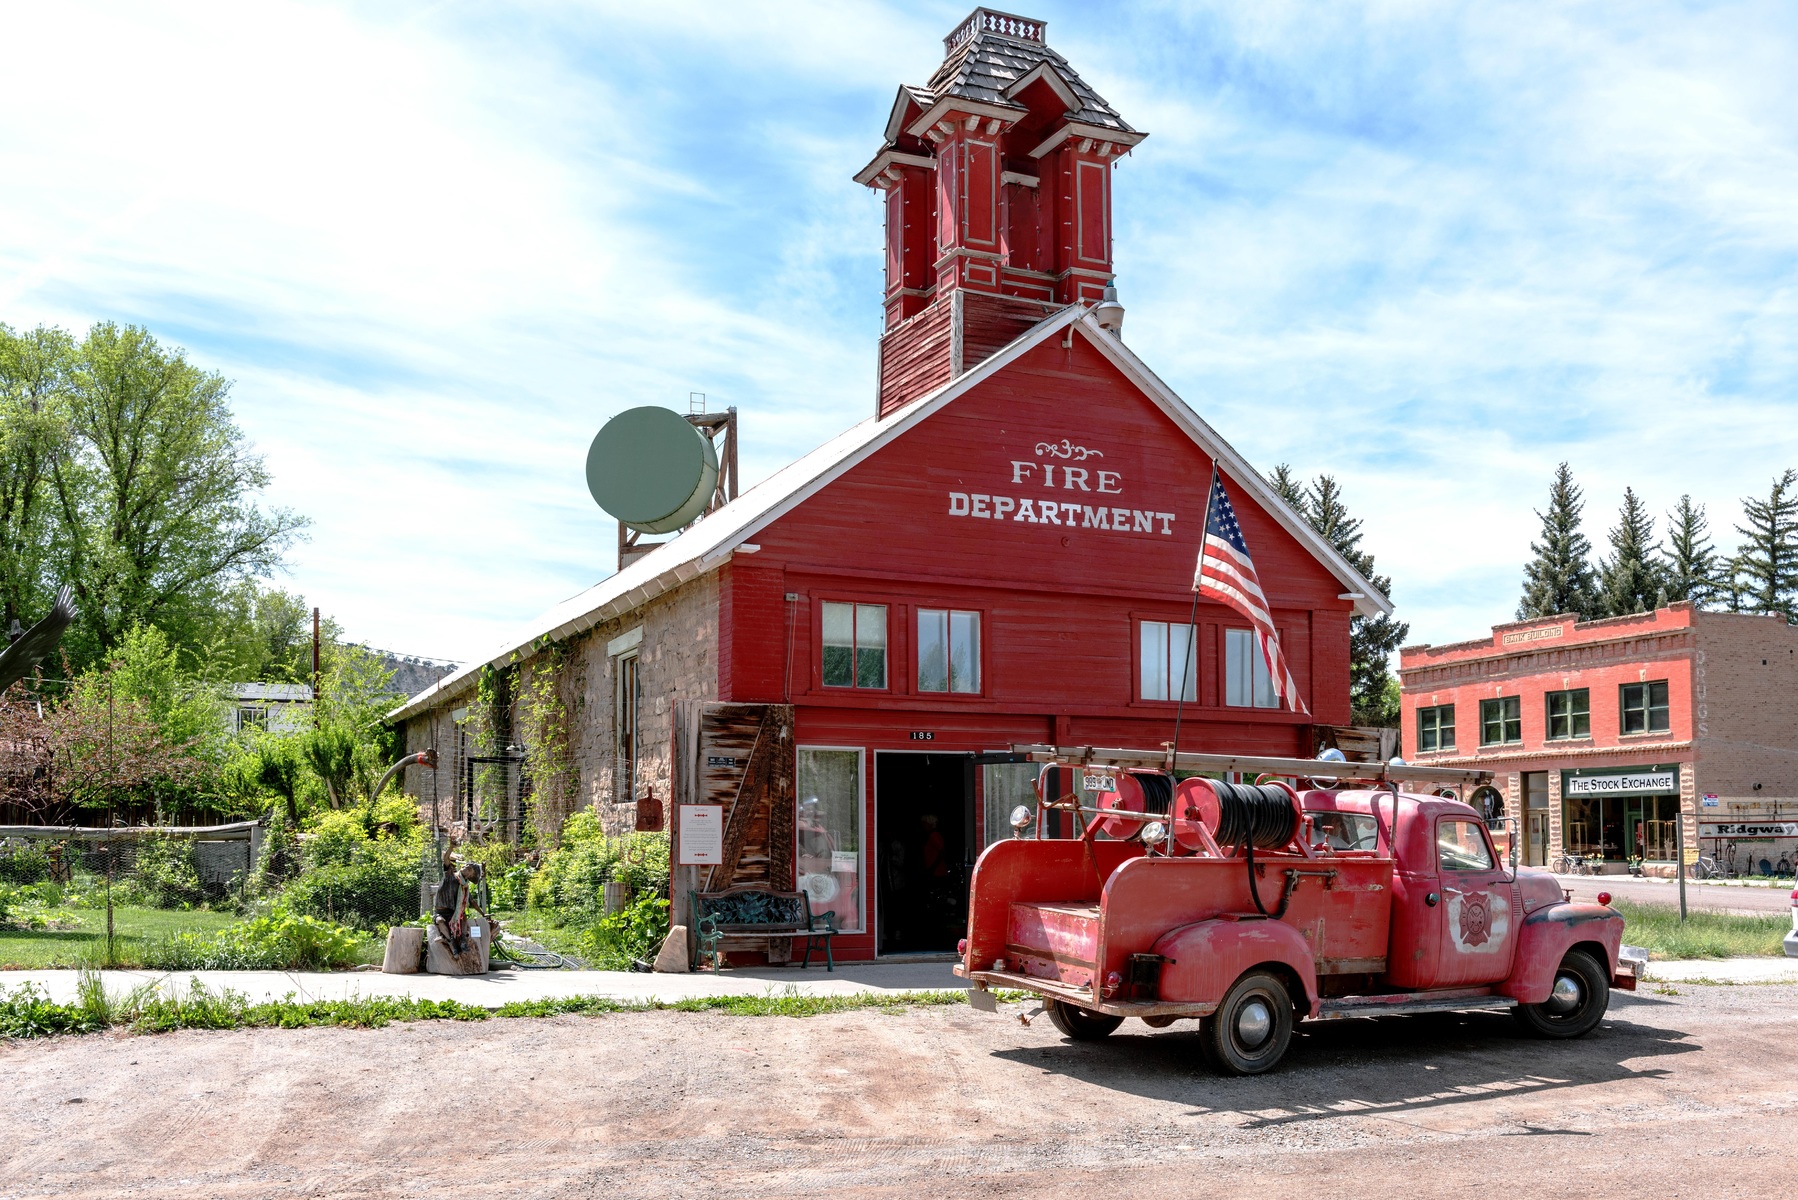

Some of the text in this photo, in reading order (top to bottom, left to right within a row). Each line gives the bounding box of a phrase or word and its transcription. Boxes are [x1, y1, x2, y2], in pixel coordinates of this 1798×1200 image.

[1010, 460, 1122, 494] FIRE
[949, 492, 1175, 535] DEPARTMENT
[1505, 628, 1561, 644] BANK BUILDING
[1696, 650, 1708, 736] DRUGS
[913, 732, 932, 740] 185
[1572, 777, 1671, 791] THE STOCK EXCHANGE
[1717, 823, 1794, 835] Ridgway
